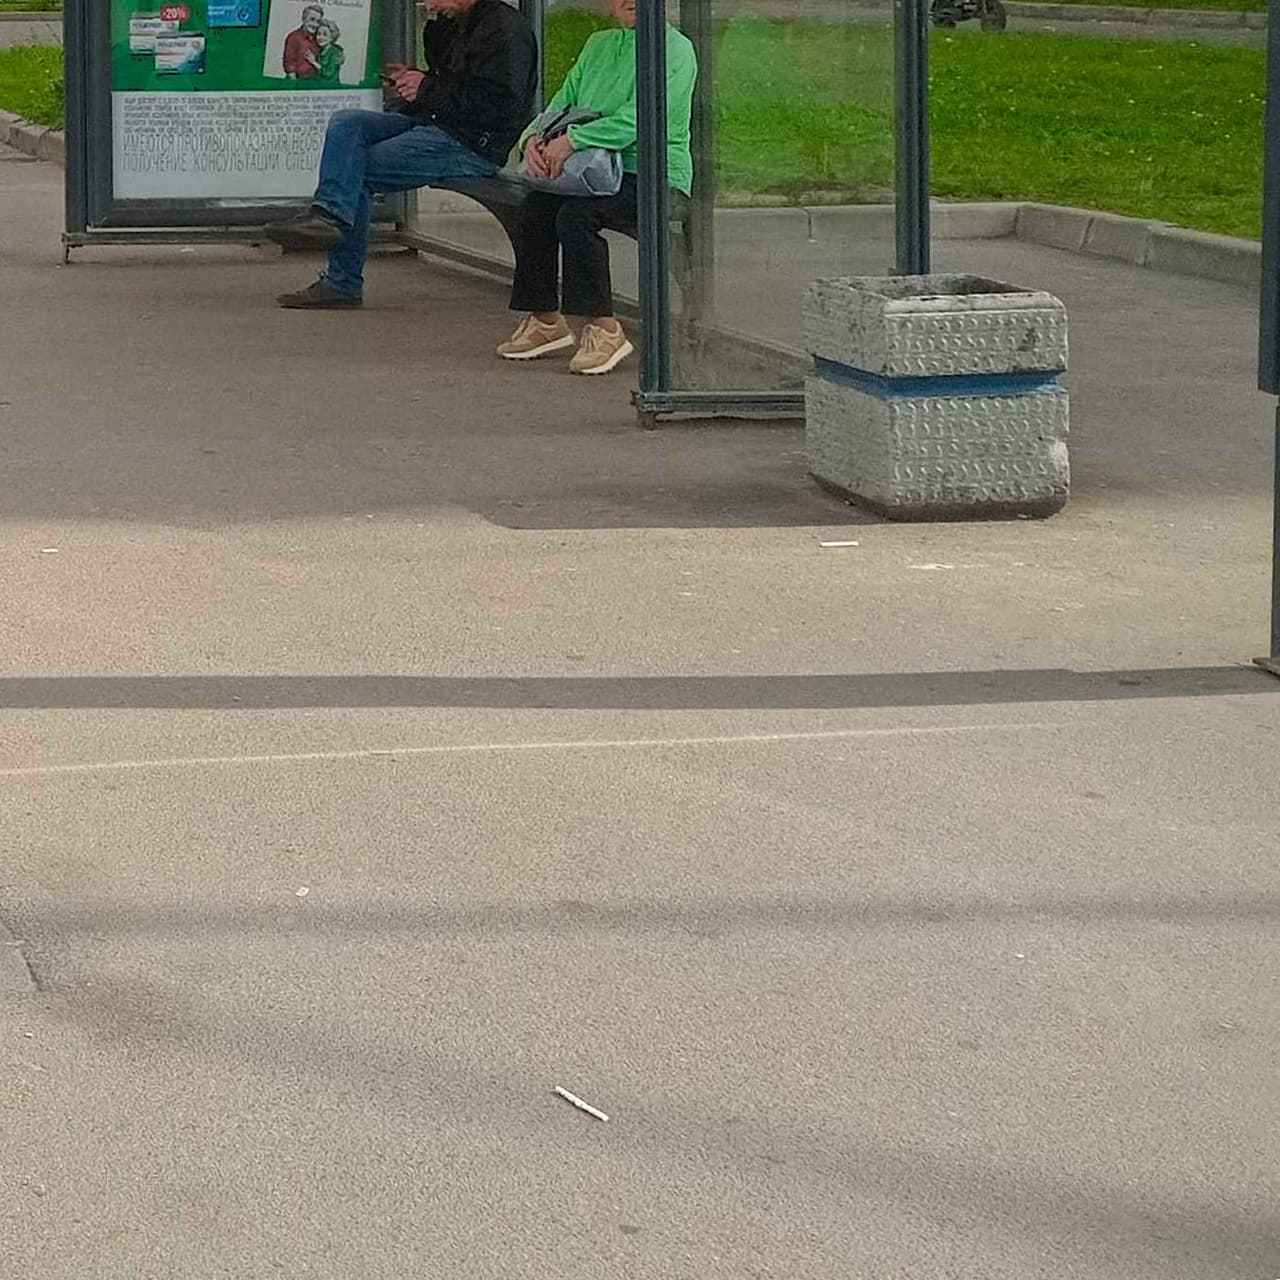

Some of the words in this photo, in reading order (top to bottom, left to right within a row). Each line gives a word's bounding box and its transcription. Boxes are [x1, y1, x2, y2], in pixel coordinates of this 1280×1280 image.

[162, 6, 188, 19] -20%
[123, 133, 174, 152] ИМЕЮТСЯ
[123, 152, 187, 172] ПОЛУЧЕНИЕ
